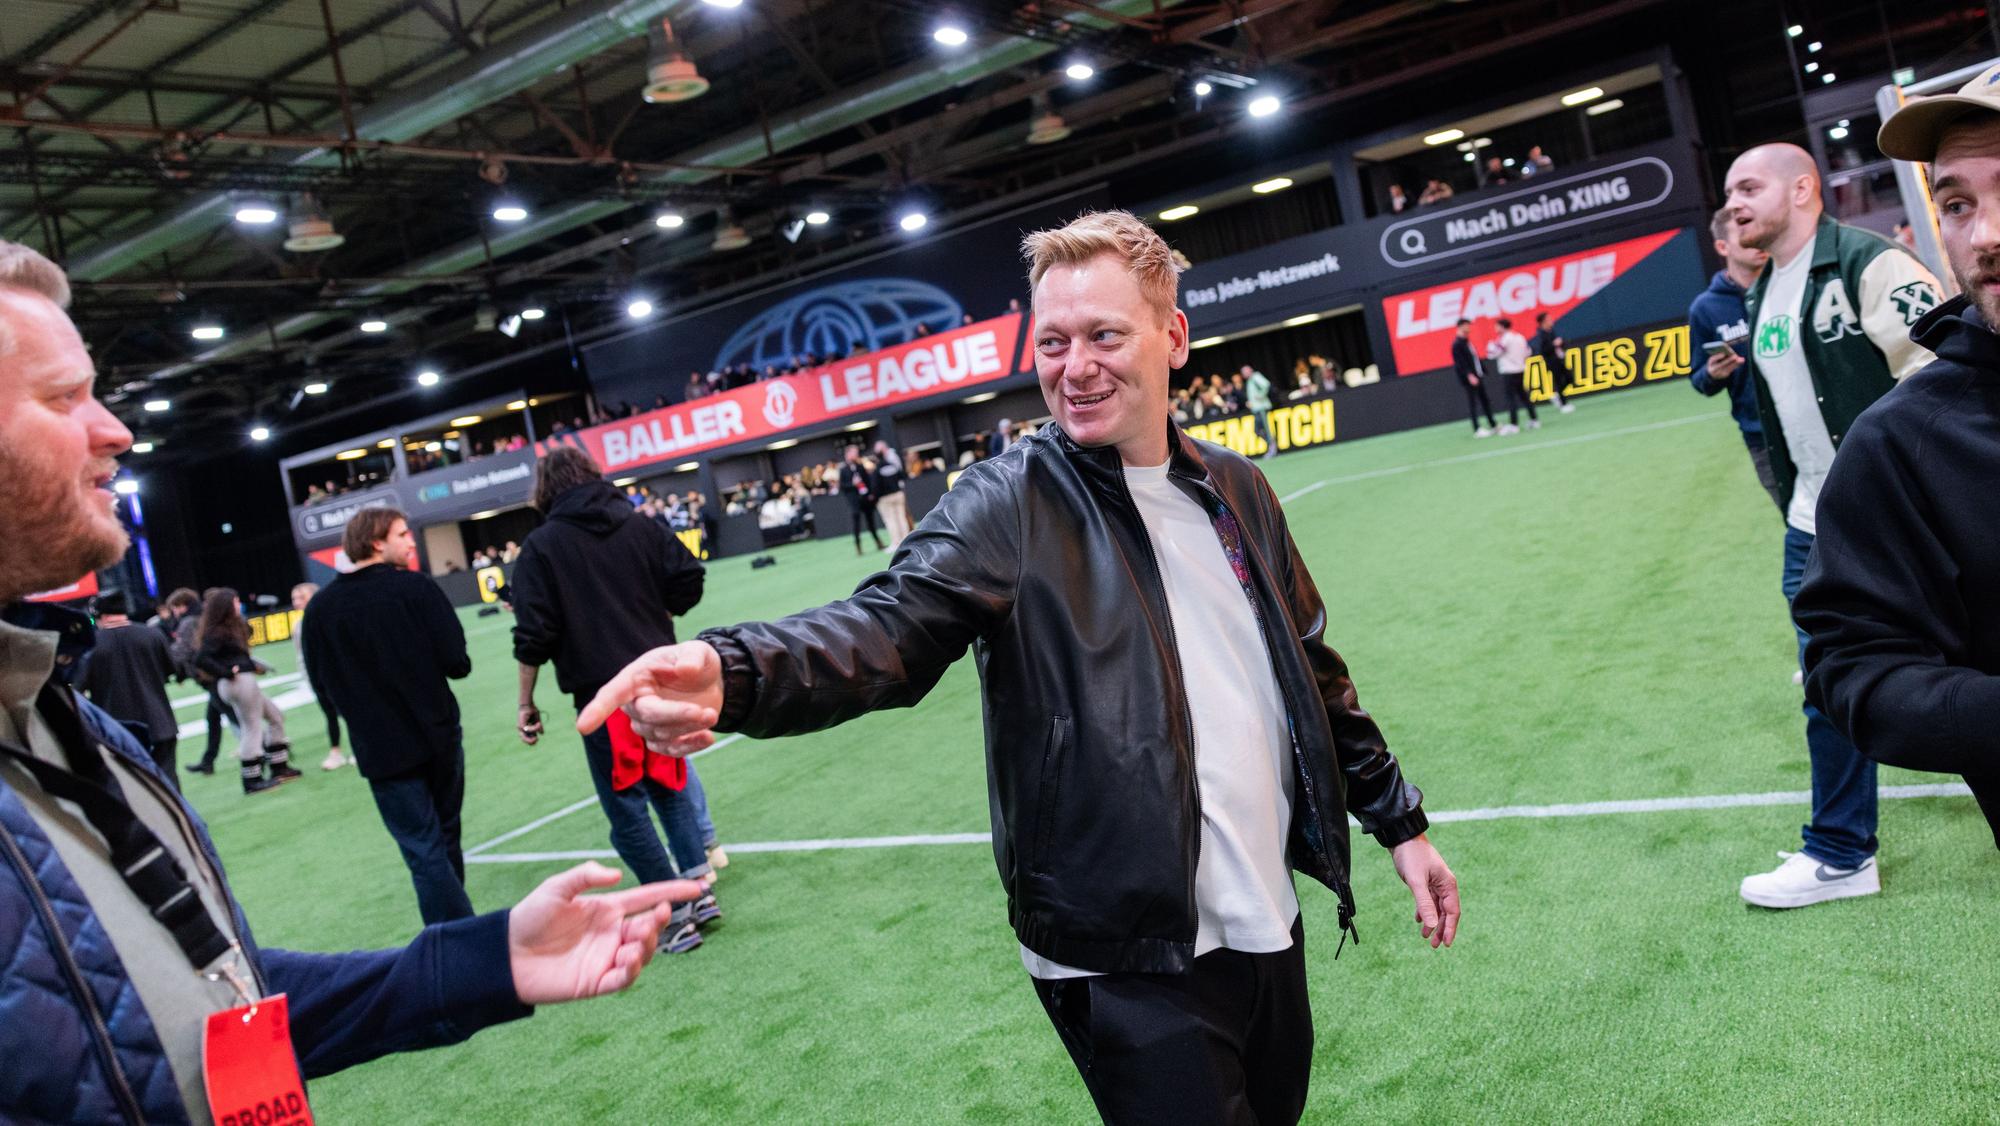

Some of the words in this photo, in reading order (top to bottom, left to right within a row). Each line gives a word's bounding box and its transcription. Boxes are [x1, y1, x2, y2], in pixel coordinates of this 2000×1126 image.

[1445, 208, 1508, 244] Mach
[1509, 193, 1566, 227] Dein
[1567, 176, 1631, 212] XING
[1185, 287, 1217, 308] Das
[1217, 252, 1341, 303] Jobs-Netzwerk
[1396, 252, 1616, 339] LEAGUE
[602, 400, 746, 467] BALLER
[819, 330, 1001, 413] LEAGUE
[1523, 338, 1637, 402] ALES
[1182, 399, 1335, 456] EMTCH
